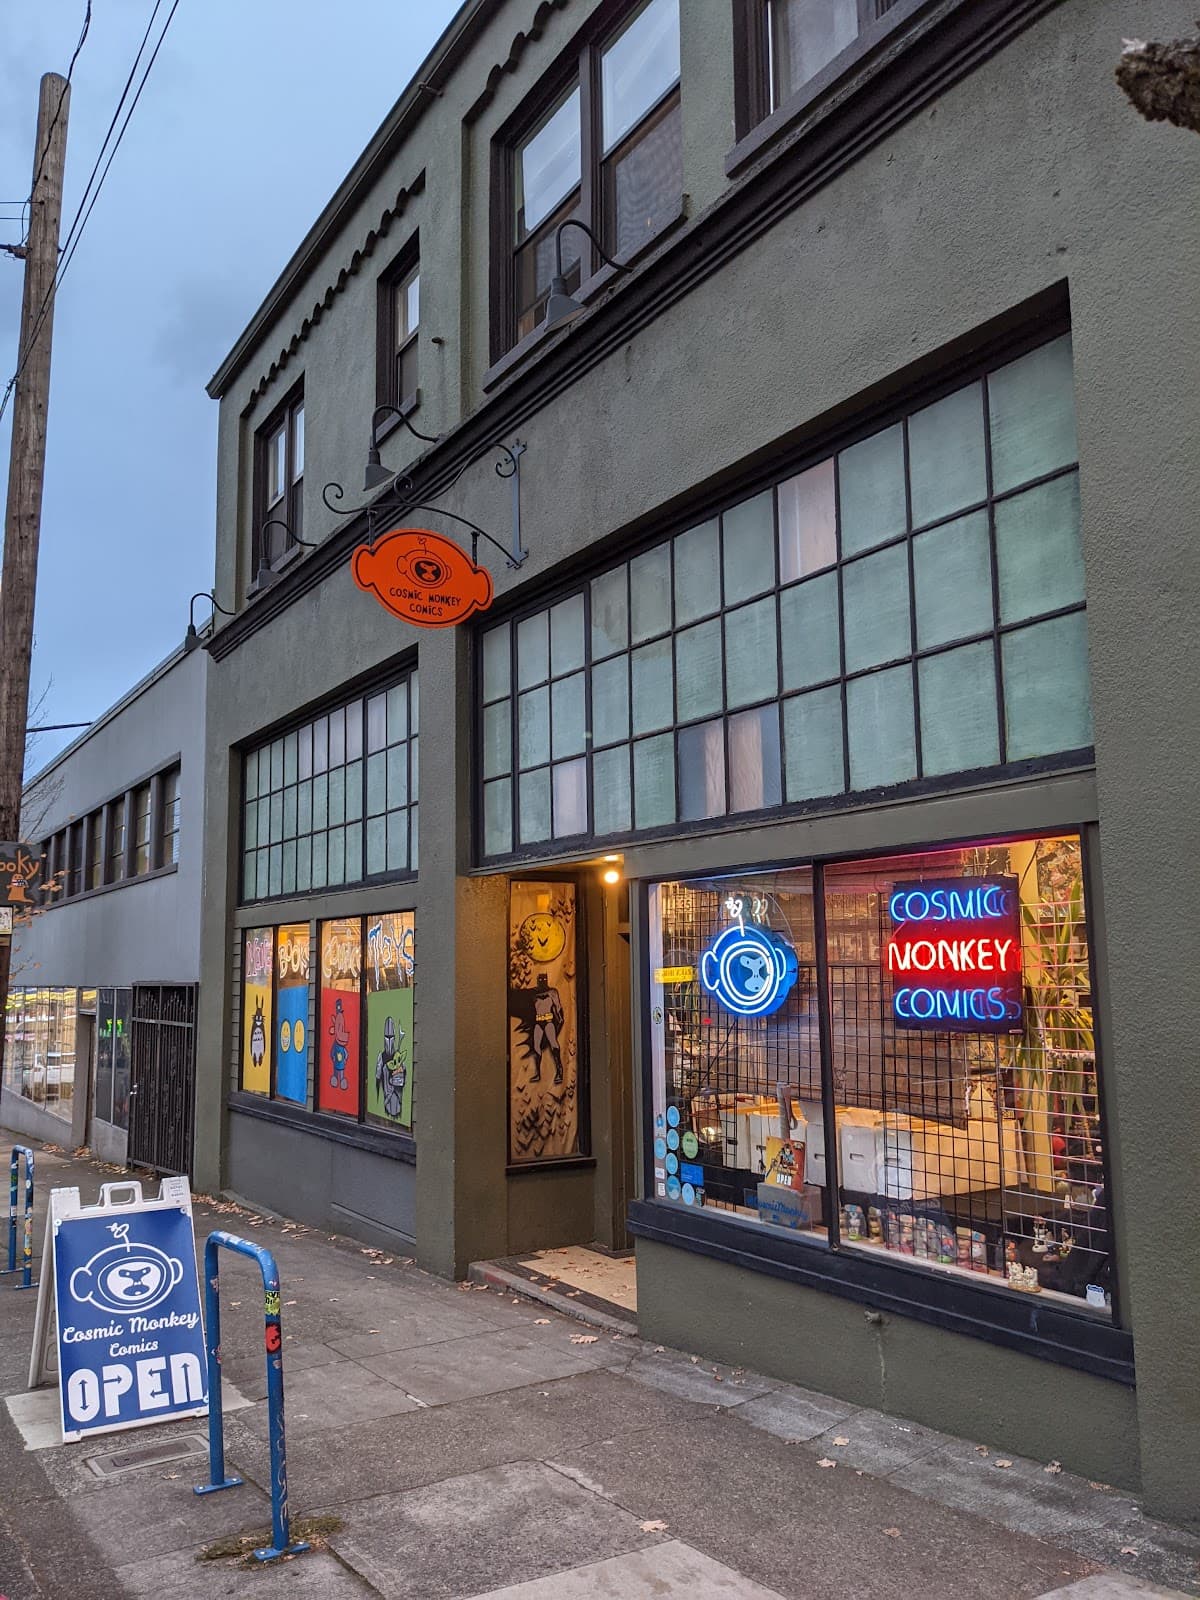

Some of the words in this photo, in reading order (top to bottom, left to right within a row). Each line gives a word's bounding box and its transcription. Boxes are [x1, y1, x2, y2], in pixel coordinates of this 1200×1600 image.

[389, 587, 422, 600] COSMIC
[428, 593, 461, 606] MONKEY
[409, 603, 443, 616] COMICS
[890, 886, 1001, 922] COSMIC
[887, 938, 1013, 972] MONKEY
[895, 986, 1006, 1020] COMICS
[62, 1320, 124, 1343] Cosmic
[129, 1311, 199, 1334] Monkey
[109, 1338, 159, 1357] Comics
[67, 1352, 204, 1422] OPEN
